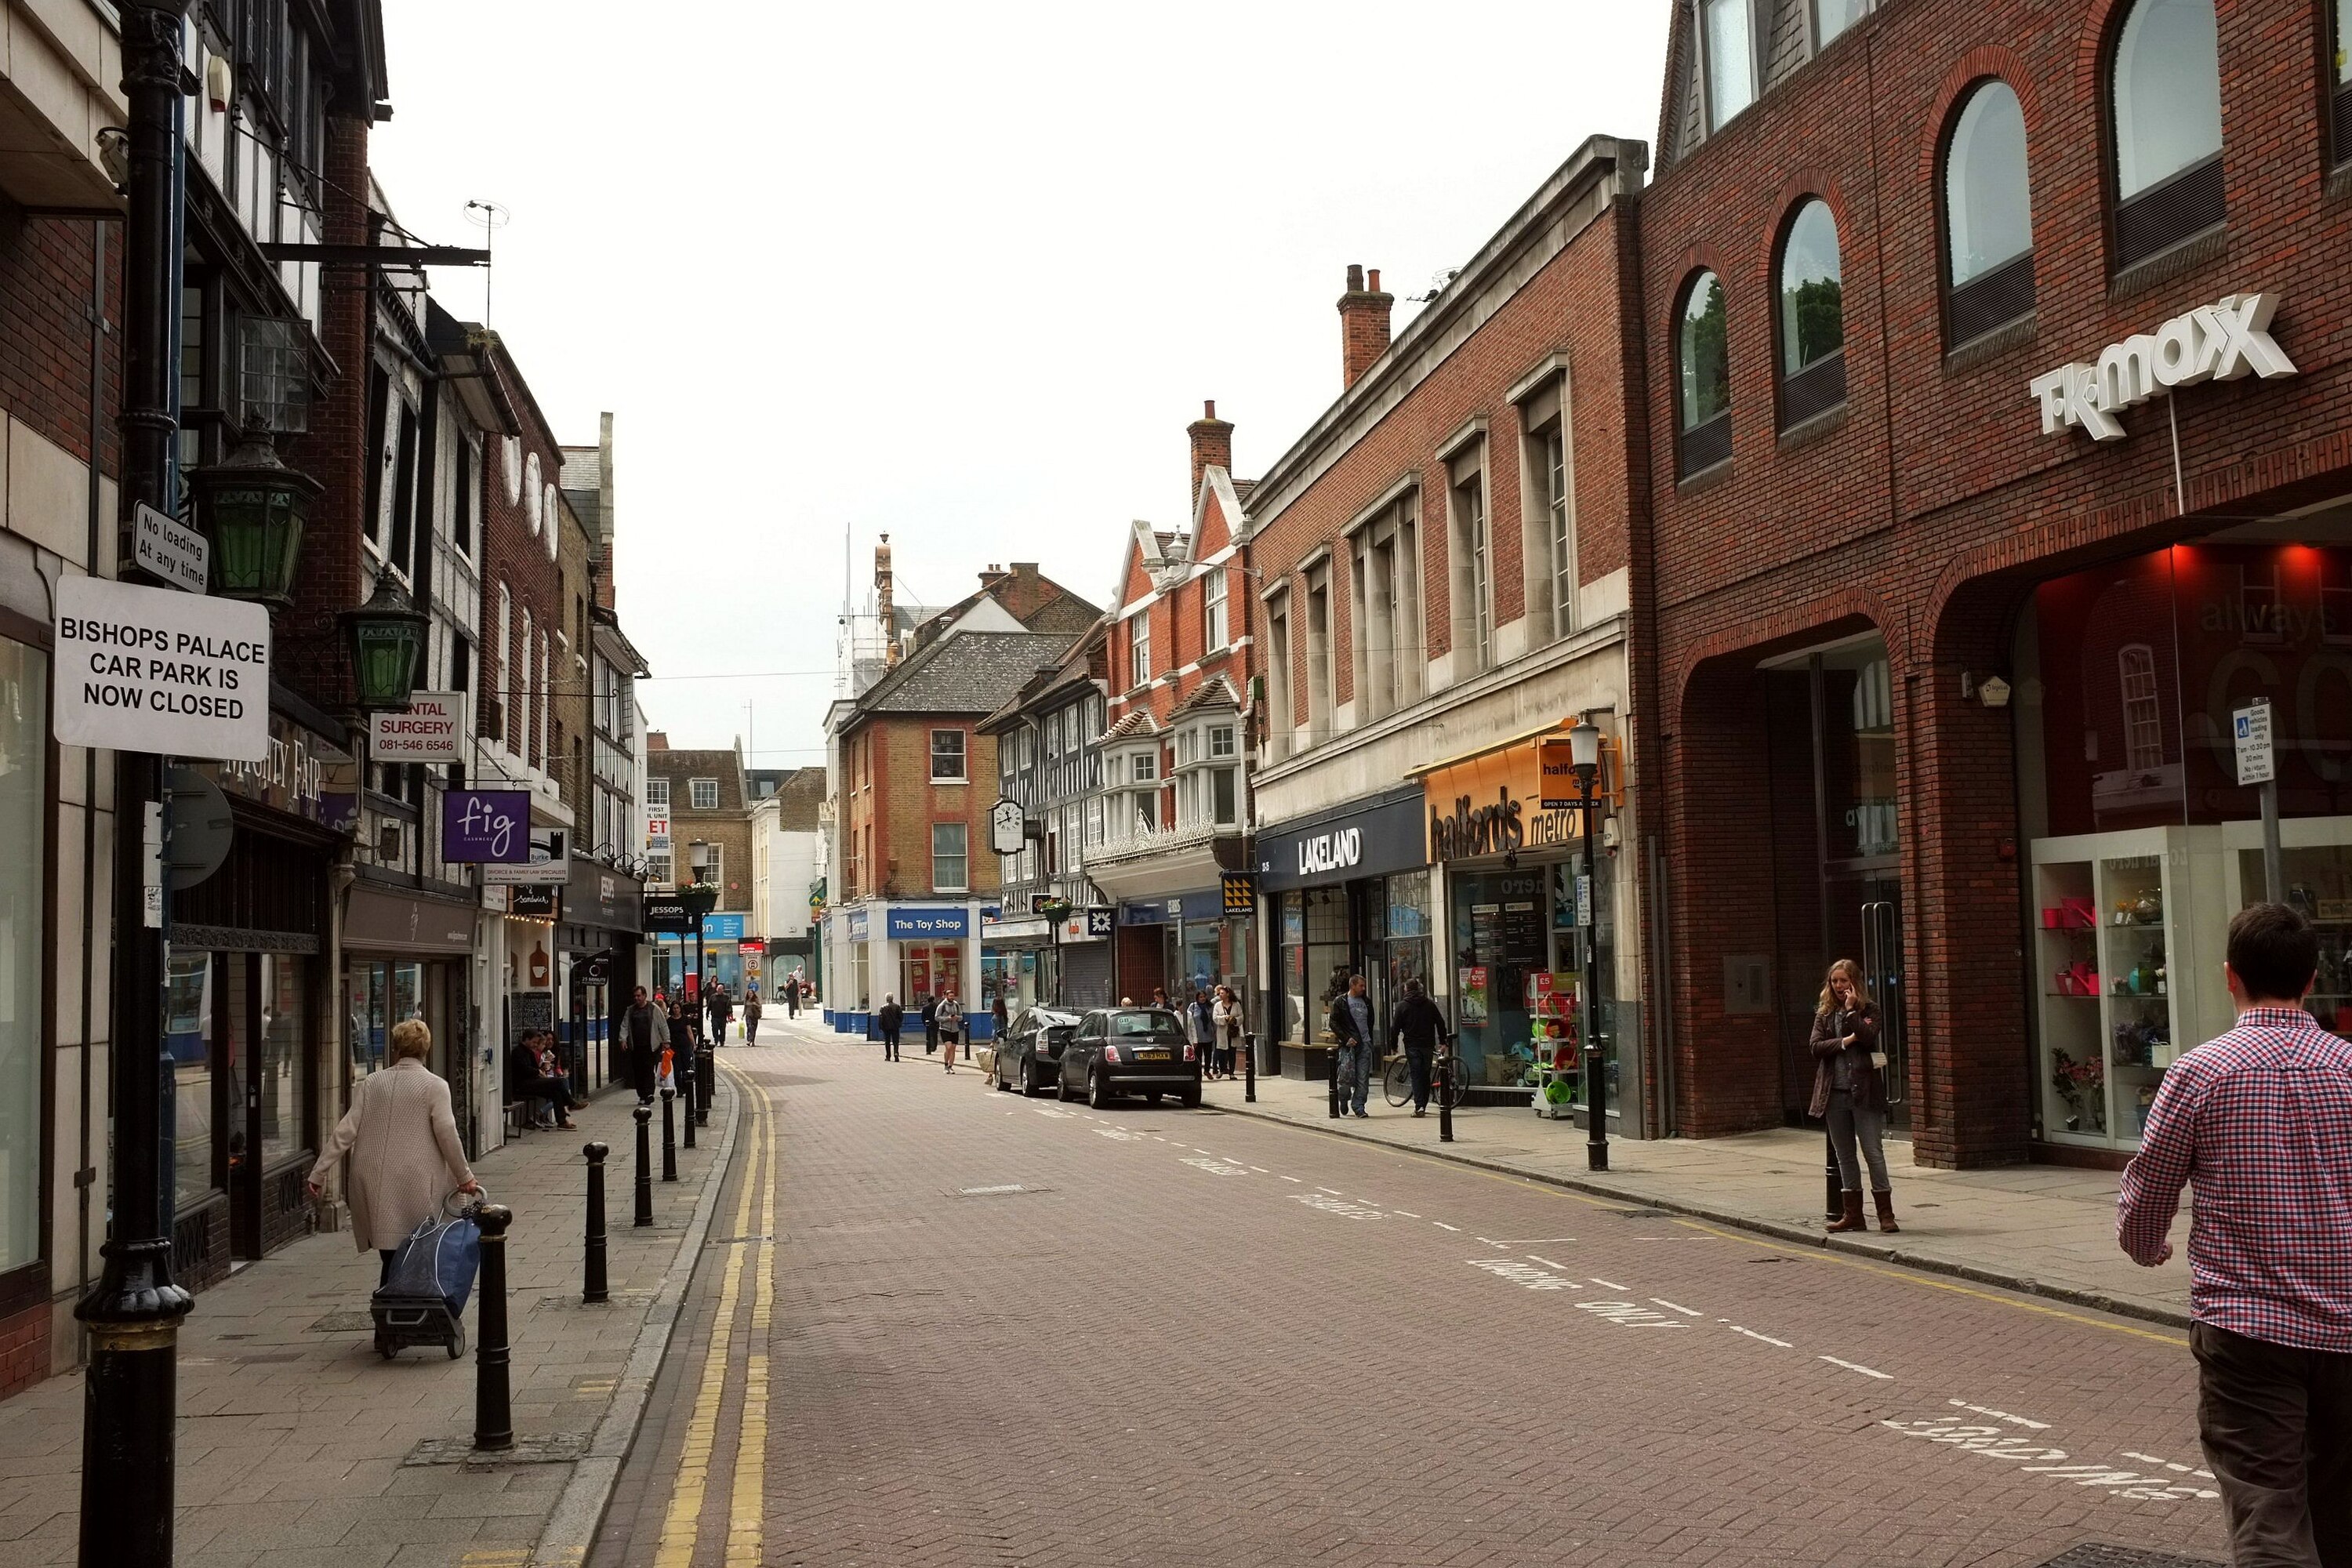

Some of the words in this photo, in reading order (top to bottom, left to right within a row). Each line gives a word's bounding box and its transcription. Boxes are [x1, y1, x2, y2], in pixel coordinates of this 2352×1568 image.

[143, 513, 158, 535] No
[164, 524, 202, 561] loading
[140, 539, 152, 559] At
[157, 551, 176, 573] any
[181, 561, 204, 586] time
[61, 617, 169, 652] BISHOPS
[176, 633, 265, 664] PALACE
[90, 652, 142, 679] CAR
[149, 659, 212, 687] PARK
[219, 668, 238, 690] IS
[84, 682, 143, 709] NOW
[150, 690, 243, 720] CLOSED
[405, 702, 447, 716] NTAL
[379, 739, 423, 750] 081-546
[426, 740, 453, 751] 6546
[380, 720, 455, 734] SURGERY
[292, 739, 321, 803] FAIR
[456, 797, 516, 857] fig
[649, 820, 668, 833] ET
[1430, 786, 1523, 862] halfords
[1531, 808, 1576, 846] metro
[1298, 827, 1362, 876] LAKELAND
[649, 906, 684, 916] JESSOPS
[895, 920, 913, 930] The
[916, 920, 933, 931] Toy
[936, 919, 961, 931] Shop
[1574, 1301, 1690, 1328] ONLY
